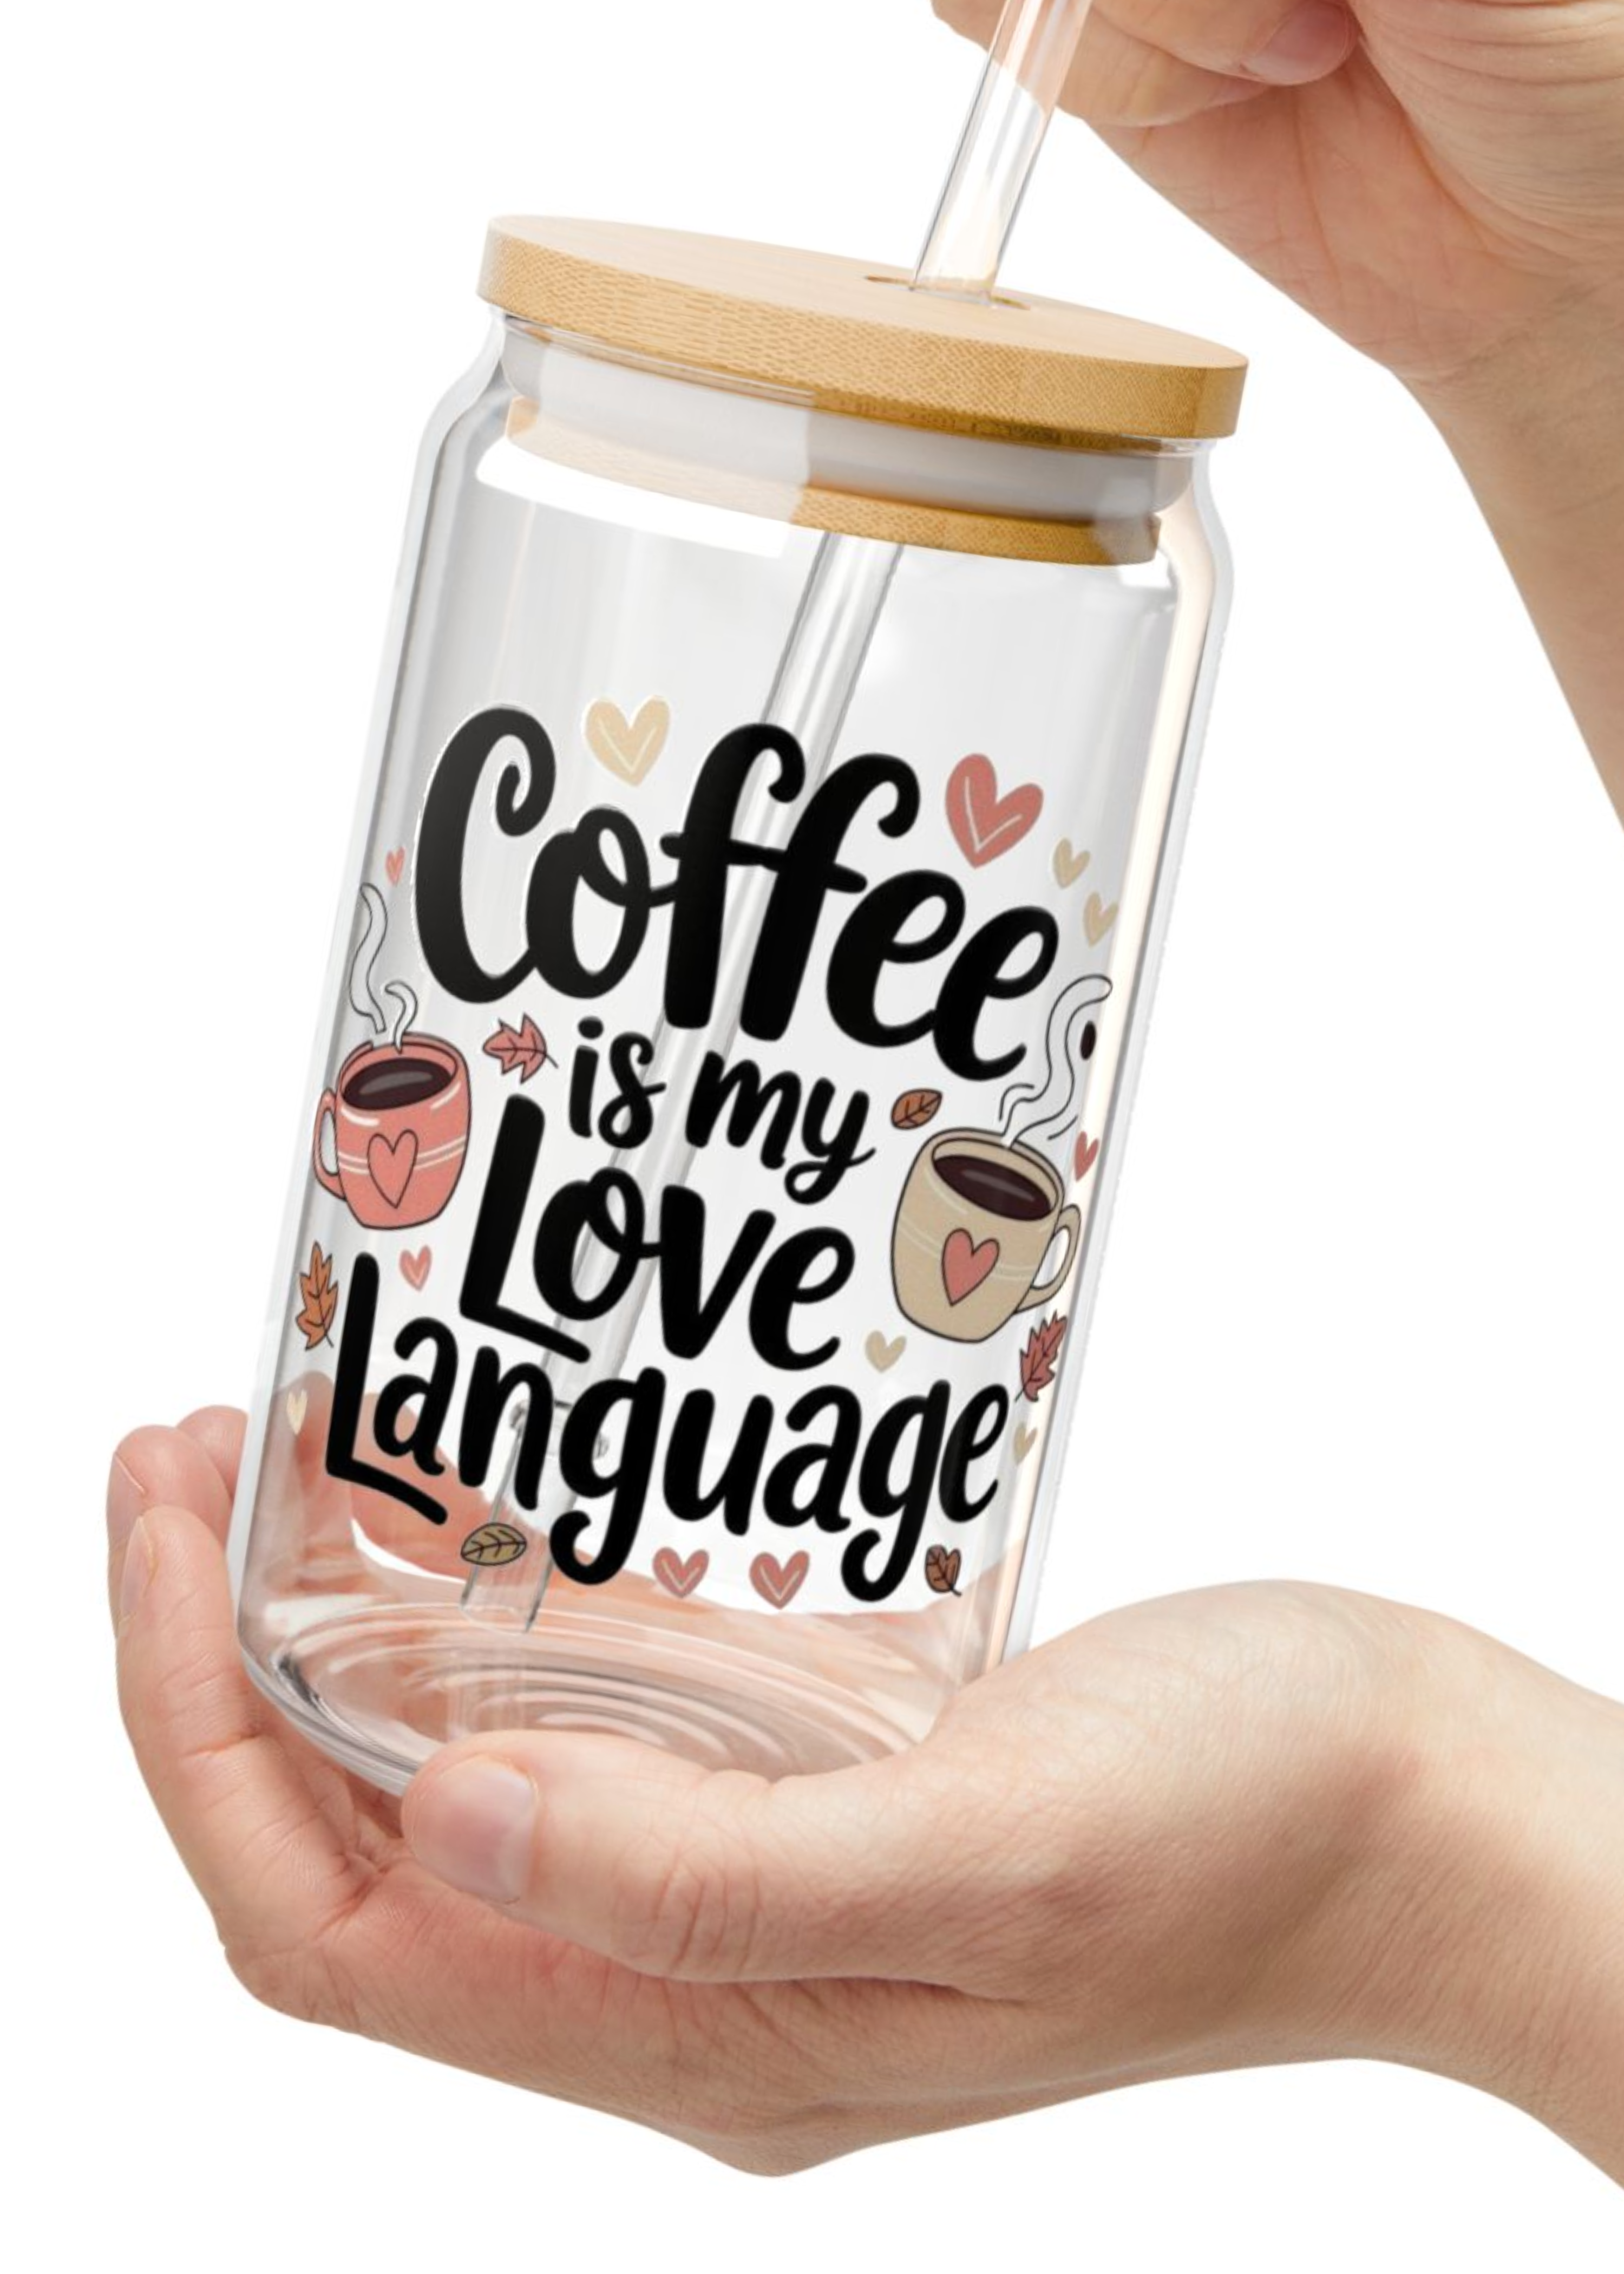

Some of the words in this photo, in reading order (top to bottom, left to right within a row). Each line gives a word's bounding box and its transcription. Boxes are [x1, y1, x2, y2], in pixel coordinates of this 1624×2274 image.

[415, 705, 1059, 1082] Coffee
[459, 1095, 855, 1371] Love
[568, 1017, 666, 1150] is
[685, 1051, 875, 1205] my
[325, 1253, 1009, 1602] Language
